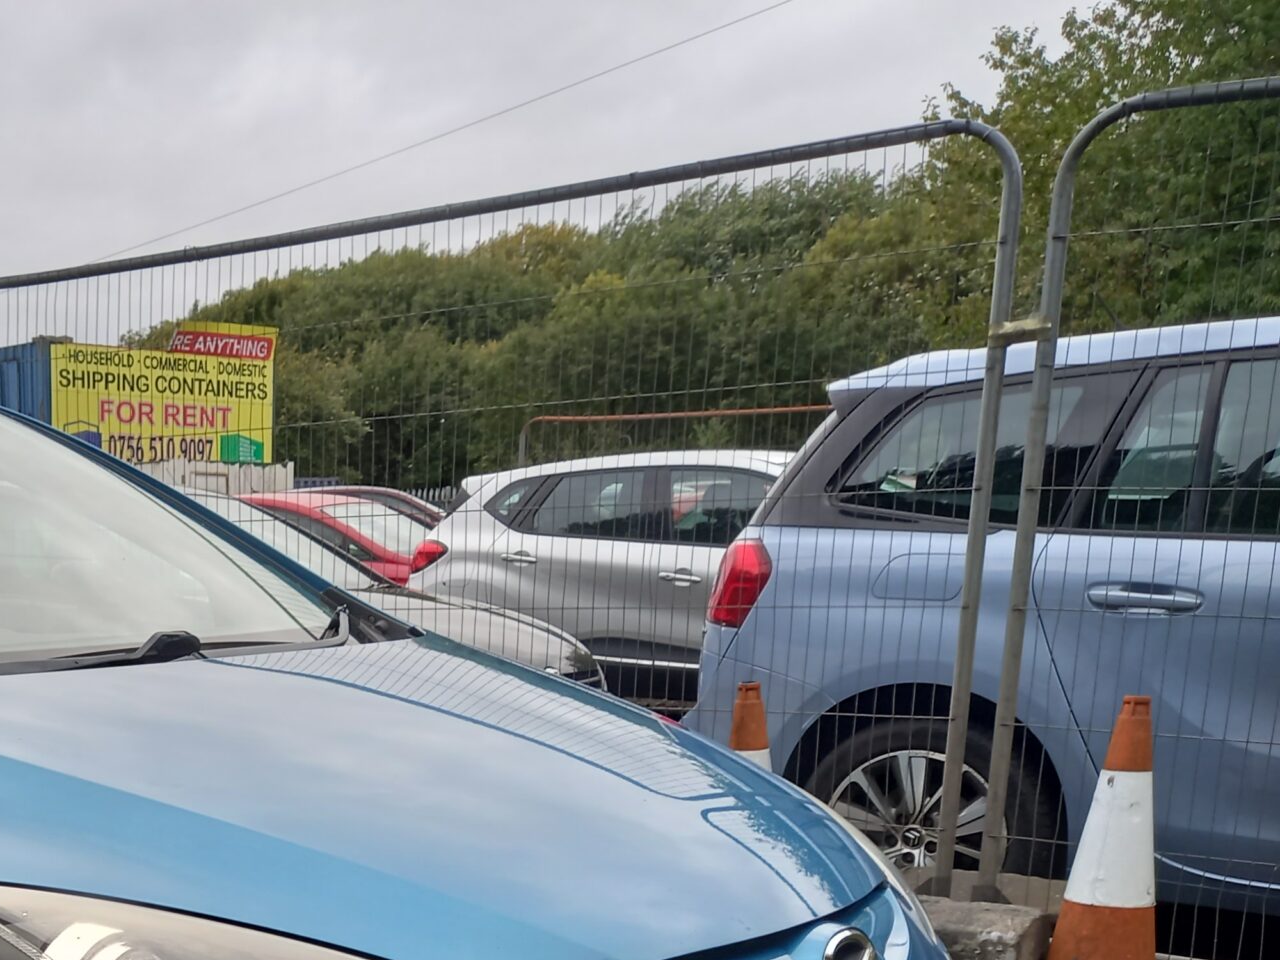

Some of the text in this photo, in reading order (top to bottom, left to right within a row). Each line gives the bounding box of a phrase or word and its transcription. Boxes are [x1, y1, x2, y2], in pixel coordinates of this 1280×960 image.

[194, 336, 268, 357] ANYTHING
[68, 348, 268, 378] HOUSEHOLD COMMERCIAL DOMESTIC
[59, 368, 268, 401] SHIPPING CONTAINERS
[100, 400, 232, 429] FOR RENT
[108, 435, 144, 462] 0756
